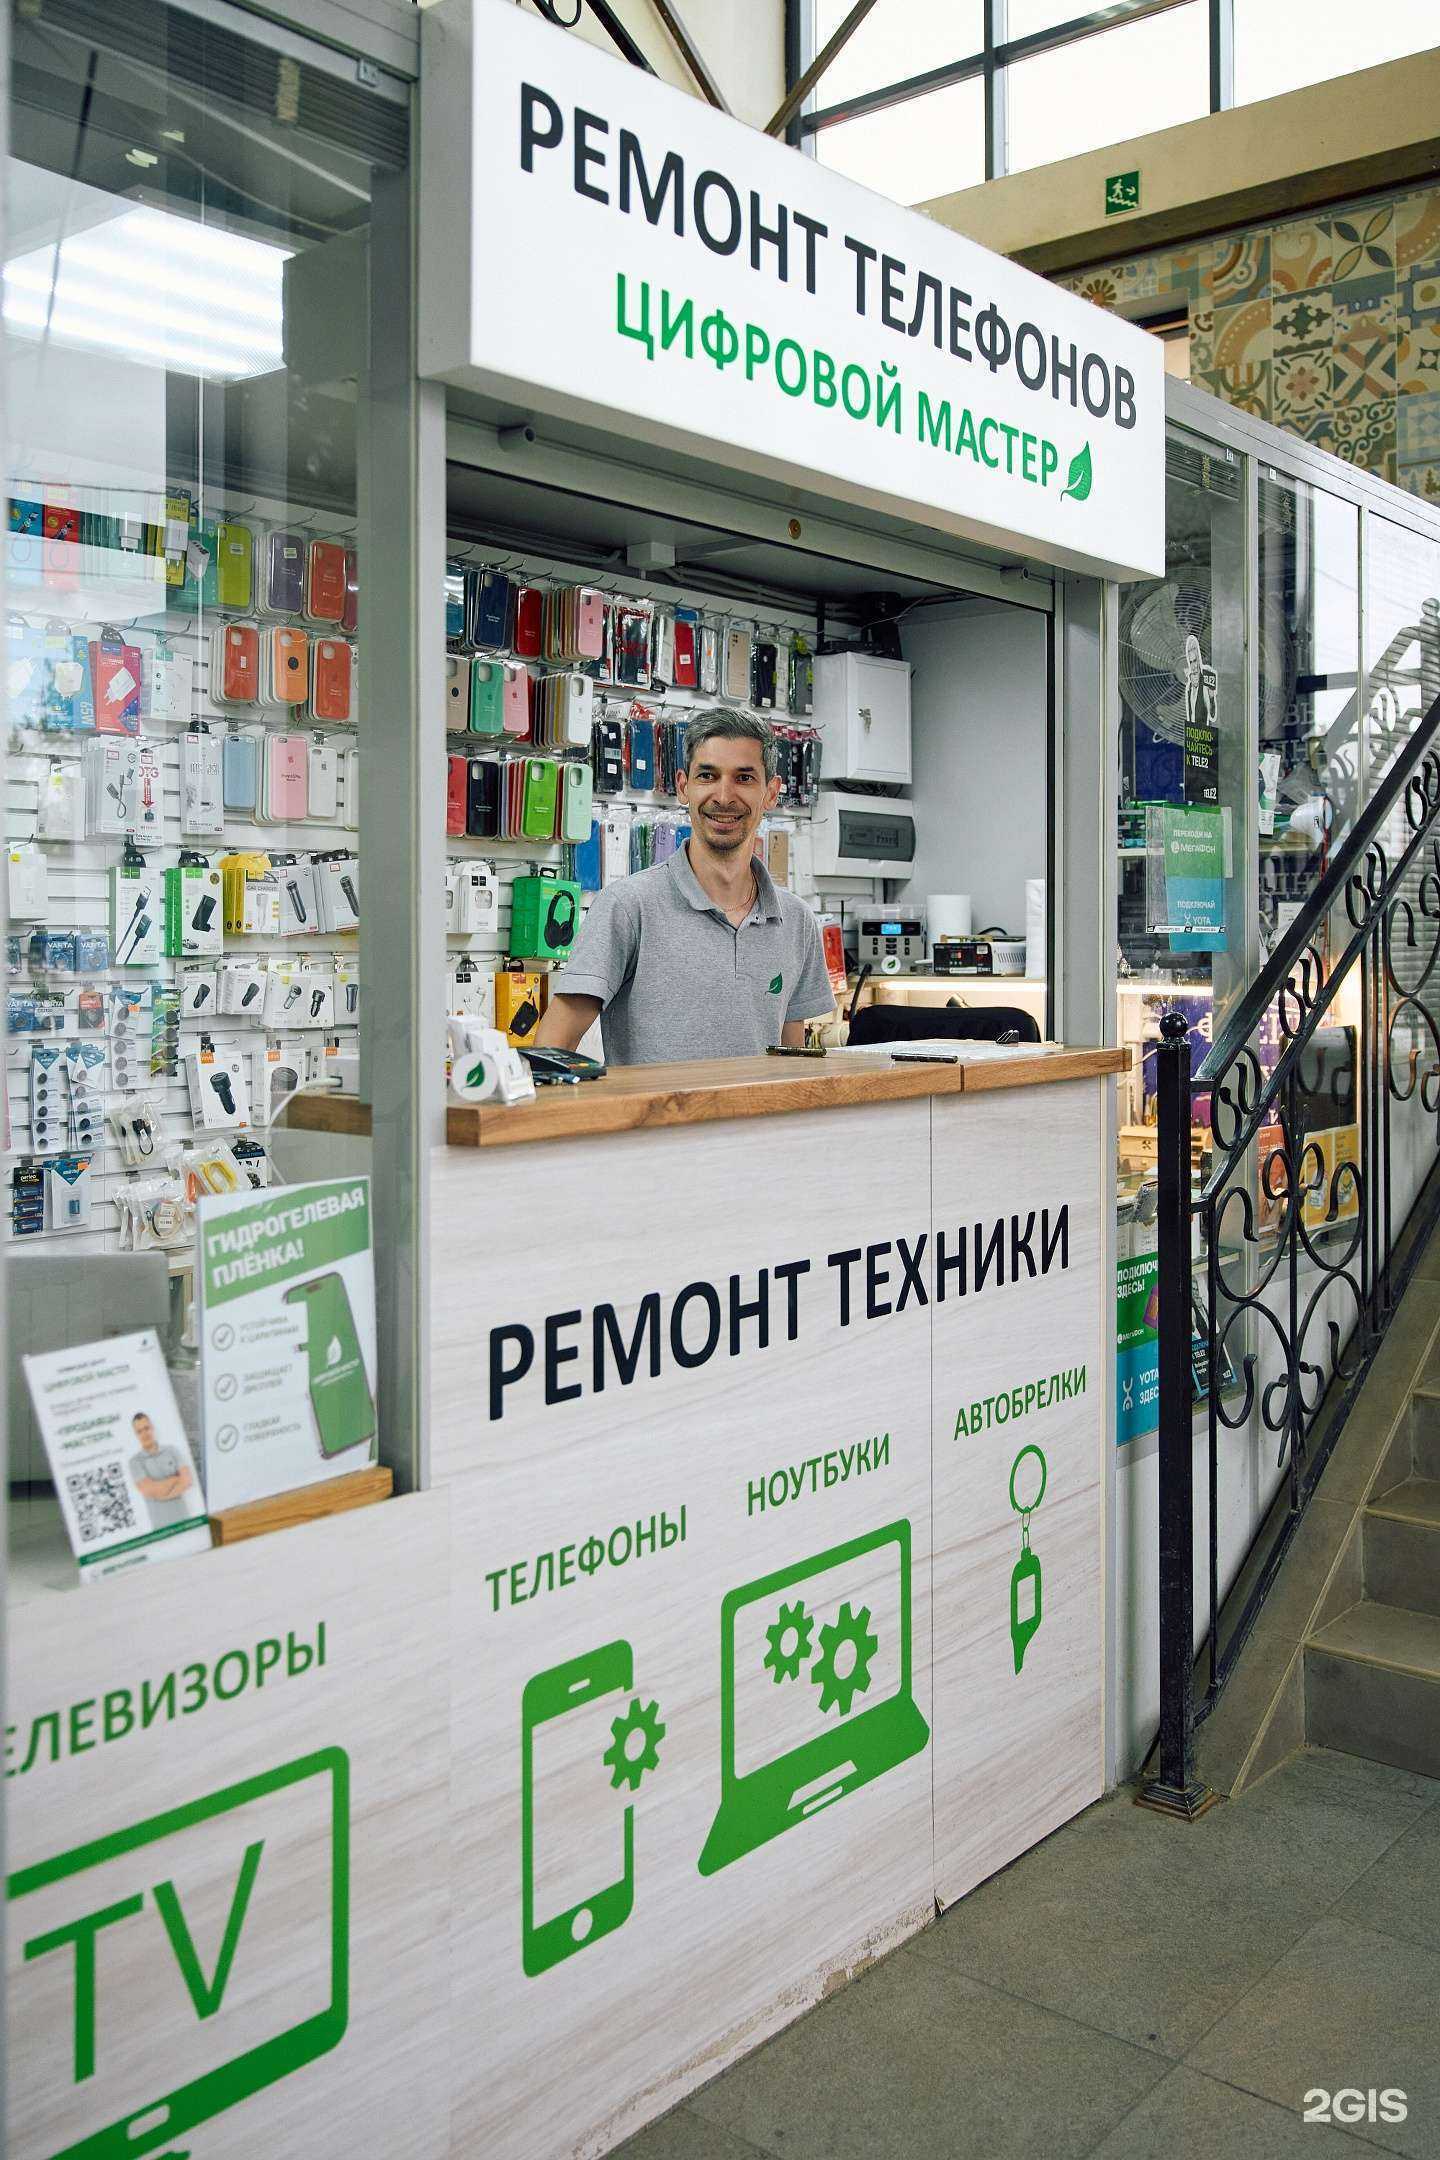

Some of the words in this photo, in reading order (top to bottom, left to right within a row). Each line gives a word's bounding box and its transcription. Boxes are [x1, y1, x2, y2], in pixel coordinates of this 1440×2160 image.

[519, 81, 828, 296] РЕМОНТ
[844, 235, 1138, 430] ТЕЛЕФОНОВ
[617, 272, 902, 435] ЦИФРОВОЙ
[917, 390, 1059, 488] МАСТЕР
[1191, 755, 1209, 769] TELE2
[206, 1187, 366, 1259] ГИДРОГЕЛЕВАЯ
[211, 1237, 305, 1290] ПЛЁНКА!
[1117, 1259, 1159, 1282] ПОДКЛЮЧ
[489, 1259, 811, 1421] РЕМОНТ
[827, 1203, 1070, 1328] ТЕХНИКИ
[954, 1364, 1087, 1441] АВТОБРЕЛКИ
[1139, 1385, 1160, 1404] ЗДЕС
[747, 1433, 892, 1517] НОУТБУКИ
[485, 1505, 687, 1612] ТЕЛЕФОНЫ
[24, 1839, 265, 2084] TV
